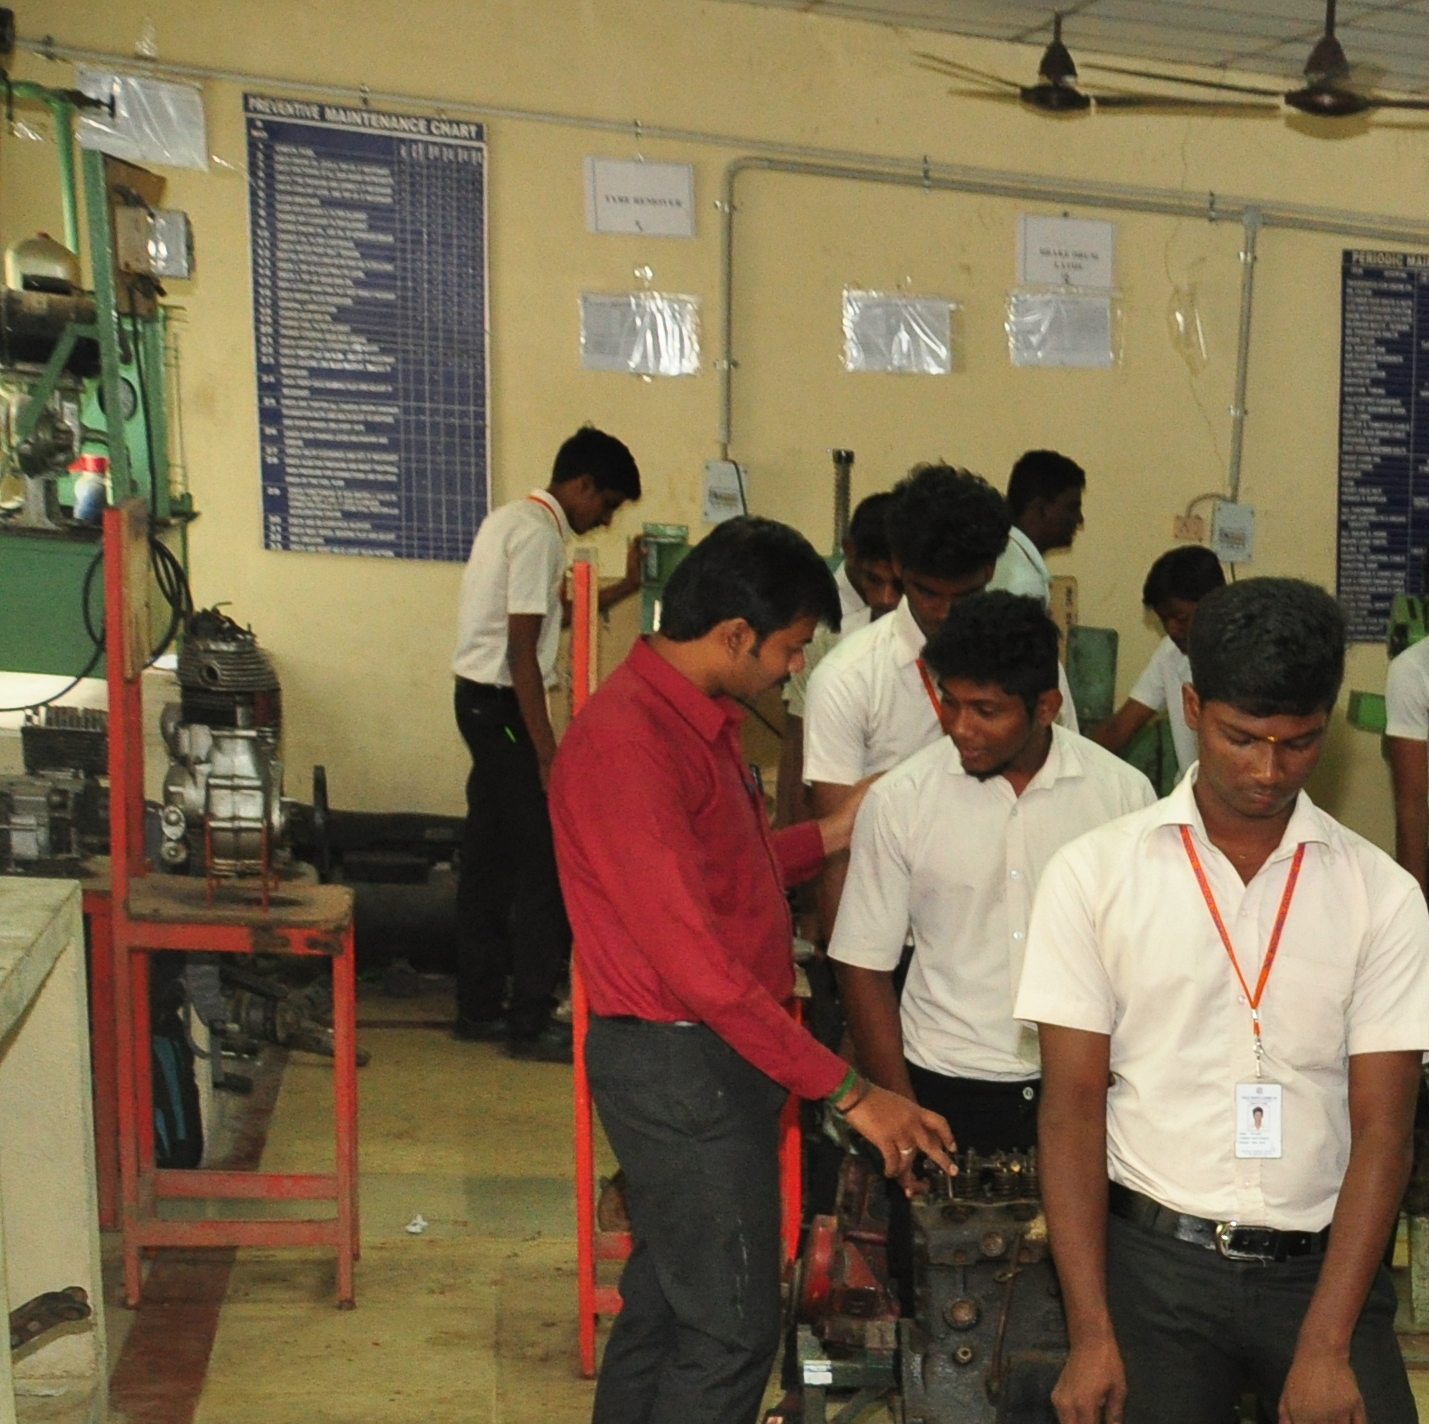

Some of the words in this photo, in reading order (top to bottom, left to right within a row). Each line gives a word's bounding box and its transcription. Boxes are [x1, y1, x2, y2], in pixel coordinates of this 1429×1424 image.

[248, 95, 320, 120] PREVENTIVE
[324, 106, 428, 134] MAINTENANCE
[430, 119, 477, 139] CHART
[1352, 251, 1403, 266] PERIODIC
